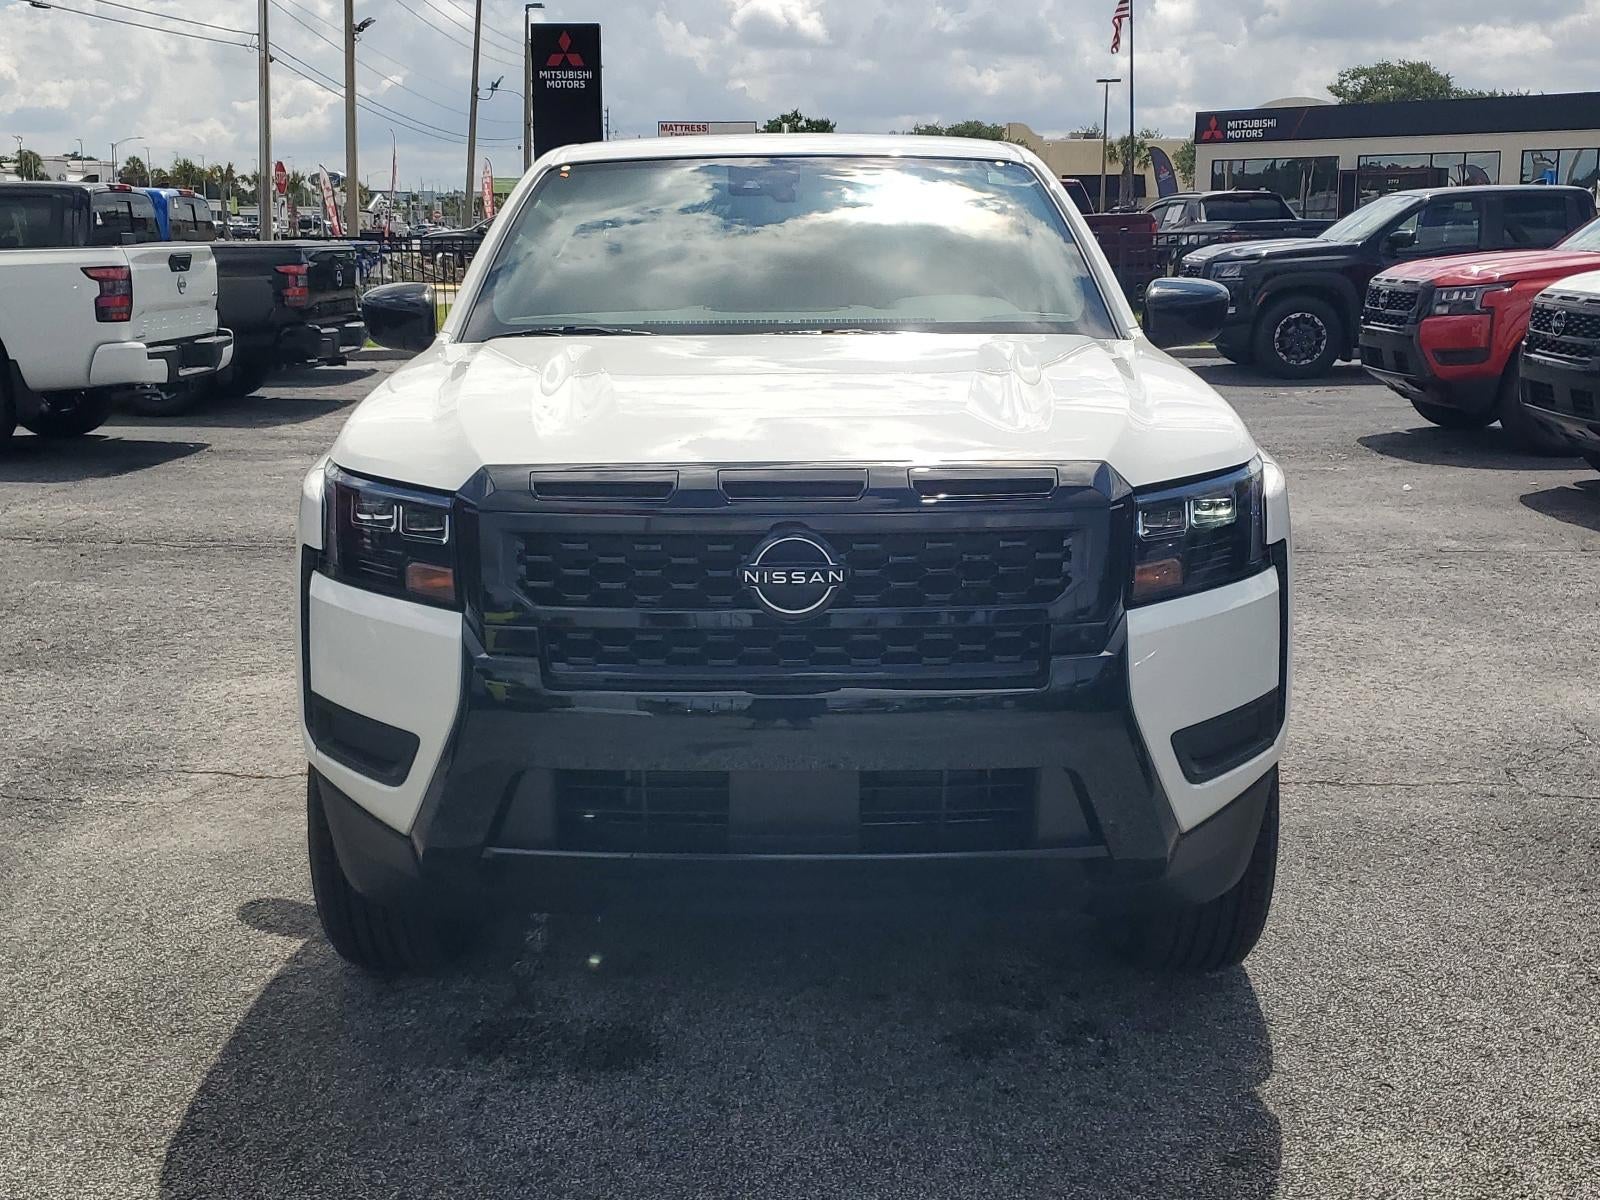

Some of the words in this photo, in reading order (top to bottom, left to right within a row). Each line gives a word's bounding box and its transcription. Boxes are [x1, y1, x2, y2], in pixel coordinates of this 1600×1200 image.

[539, 70, 592, 79] MITSUBISHI
[546, 80, 586, 89] MOTORS
[660, 123, 707, 132] MATTRESS
[1227, 118, 1277, 129] MITSUBISHI
[1226, 129, 1263, 139] MOTORS
[744, 570, 844, 584] NISSAN
